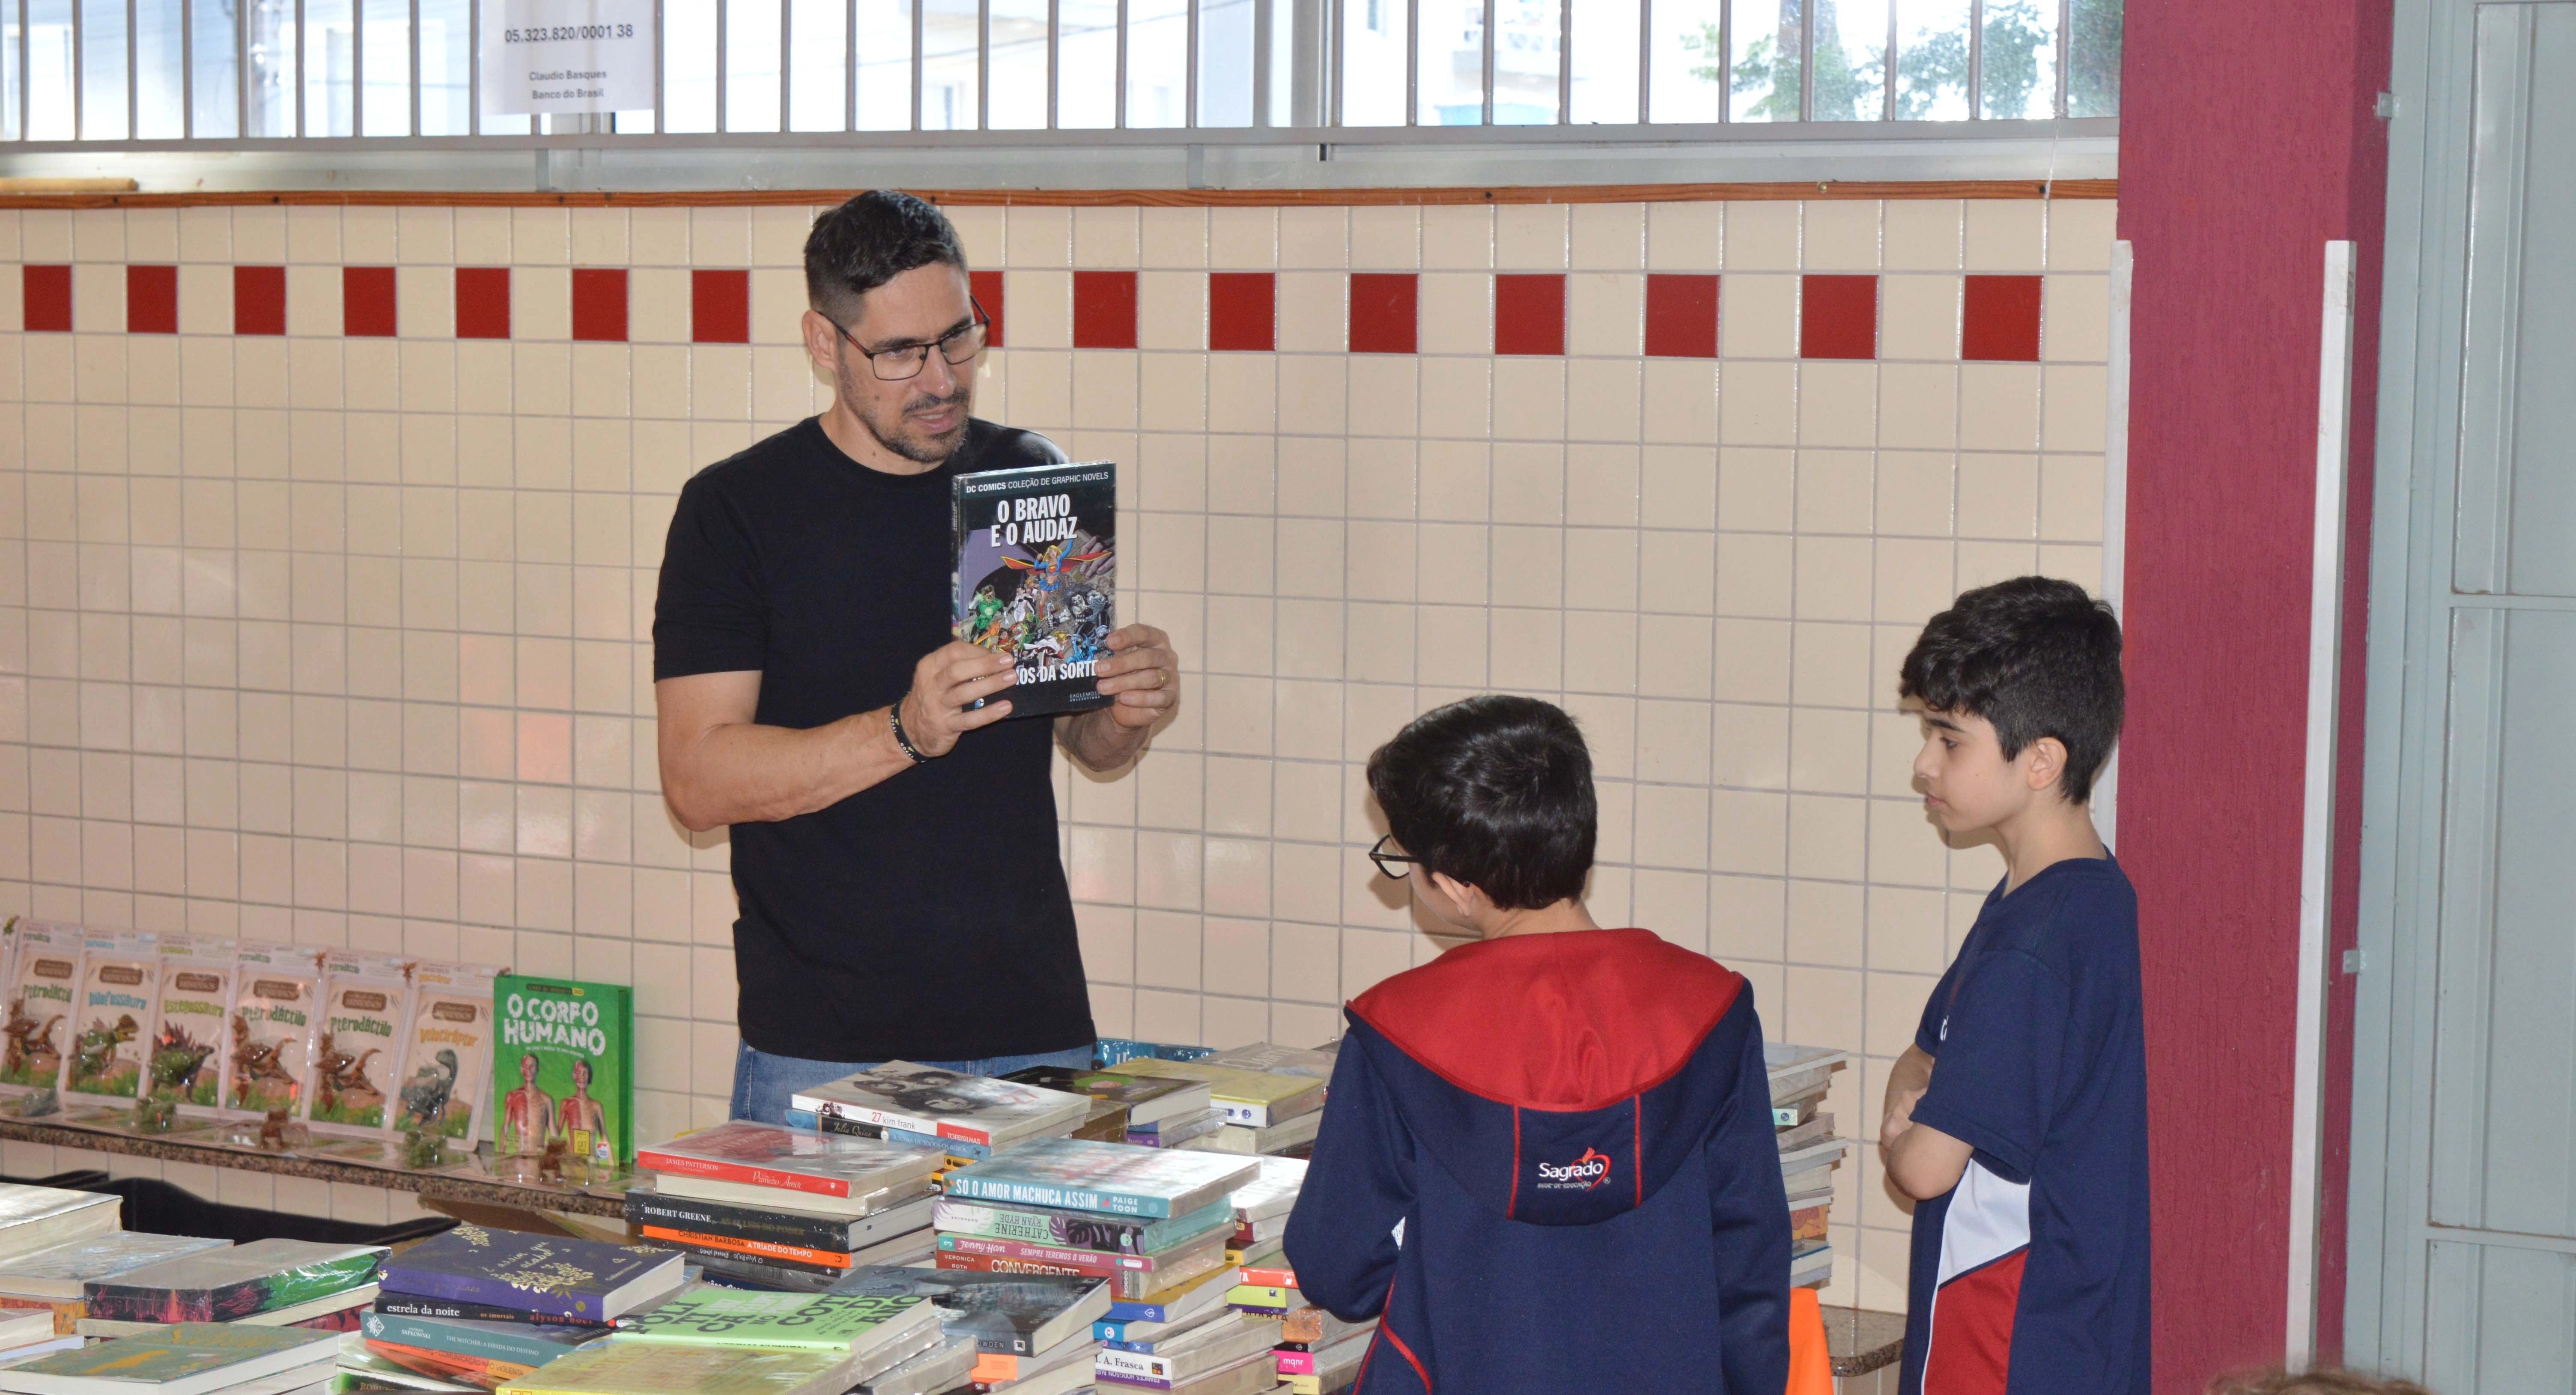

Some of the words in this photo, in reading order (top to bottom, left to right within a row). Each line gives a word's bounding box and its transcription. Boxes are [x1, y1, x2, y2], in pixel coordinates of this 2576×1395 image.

[505, 25, 612, 42] 05.323.820/0001
[617, 24, 633, 37] 38
[529, 71, 565, 81] Claudio
[566, 70, 607, 80] Basques
[532, 90, 561, 99] Banco
[563, 89, 575, 98] do
[577, 88, 605, 98] Brasil
[966, 485, 977, 493] DC
[978, 482, 1007, 492] COMICS
[1008, 477, 1039, 489] COLEÇÃO
[1052, 474, 1081, 485] GRAPHIC
[1082, 471, 1109, 481] NOVELS
[997, 500, 1010, 524] O
[1015, 494, 1070, 522] BRAVO
[991, 525, 1001, 548] E
[1006, 522, 1018, 546] O
[1023, 516, 1078, 544] AUDAZ
[1039, 665, 1057, 683] DA
[507, 993, 524, 1019] O
[527, 998, 599, 1026] CORPO
[504, 1018, 606, 1056] HUMANO
[872, 1112, 882, 1123] 27
[883, 1116, 895, 1126] kim
[898, 1119, 915, 1130] frank
[830, 1121, 850, 1135] Julia
[852, 1125, 873, 1138] Quinn
[923, 1140, 941, 1149] TODOS
[665, 1158, 685, 1166] JAMES
[685, 1161, 719, 1171] PATTERSON
[1538, 1160, 1604, 1182] Sagrado
[781, 1175, 802, 1189] Amor
[956, 1177, 969, 1195] SÓ
[972, 1180, 978, 1196] O
[981, 1182, 1010, 1199] AMOR
[1013, 1185, 1061, 1205] MACHUCA
[1064, 1191, 1098, 1209] ASSIM
[1113, 1196, 1139, 1205] PAIGE
[644, 1206, 677, 1218] ROBERT
[679, 1212, 712, 1223] GREENE
[1113, 1204, 1138, 1213] TOON
[999, 1213, 1020, 1224] HYDE
[1021, 1215, 1044, 1228] RYAN
[995, 1222, 1049, 1240] CATHERINE
[678, 1230, 713, 1242] CHRISTIAN
[714, 1235, 745, 1247] BARBOSA
[752, 1242, 776, 1252] TRÍADE
[777, 1246, 788, 1254] DO
[789, 1247, 813, 1258] TEMPO
[958, 1240, 985, 1254] Jenny
[985, 1241, 1006, 1253] Han
[497, 1251, 528, 1268] assim
[944, 1254, 975, 1263] VERONICA
[1020, 1248, 1044, 1258] SEMPRE
[1045, 1250, 1071, 1261] TEREMOS
[1072, 1252, 1077, 1261] O
[1078, 1253, 1097, 1263] VERÃO
[387, 1303, 418, 1314] estrela
[421, 1304, 432, 1315] da
[435, 1305, 460, 1317] noite
[530, 1312, 564, 1323] alyson
[401, 1329, 431, 1339] SAPKOWSKI
[488, 1342, 506, 1350] ESPADA
[516, 1347, 540, 1356] DESTINO
[496, 1364, 524, 1376] VIOLENTA
[1104, 1356, 1112, 1365] A.
[1115, 1357, 1144, 1370] Frasca
[1283, 1358, 1304, 1368] mqnr
